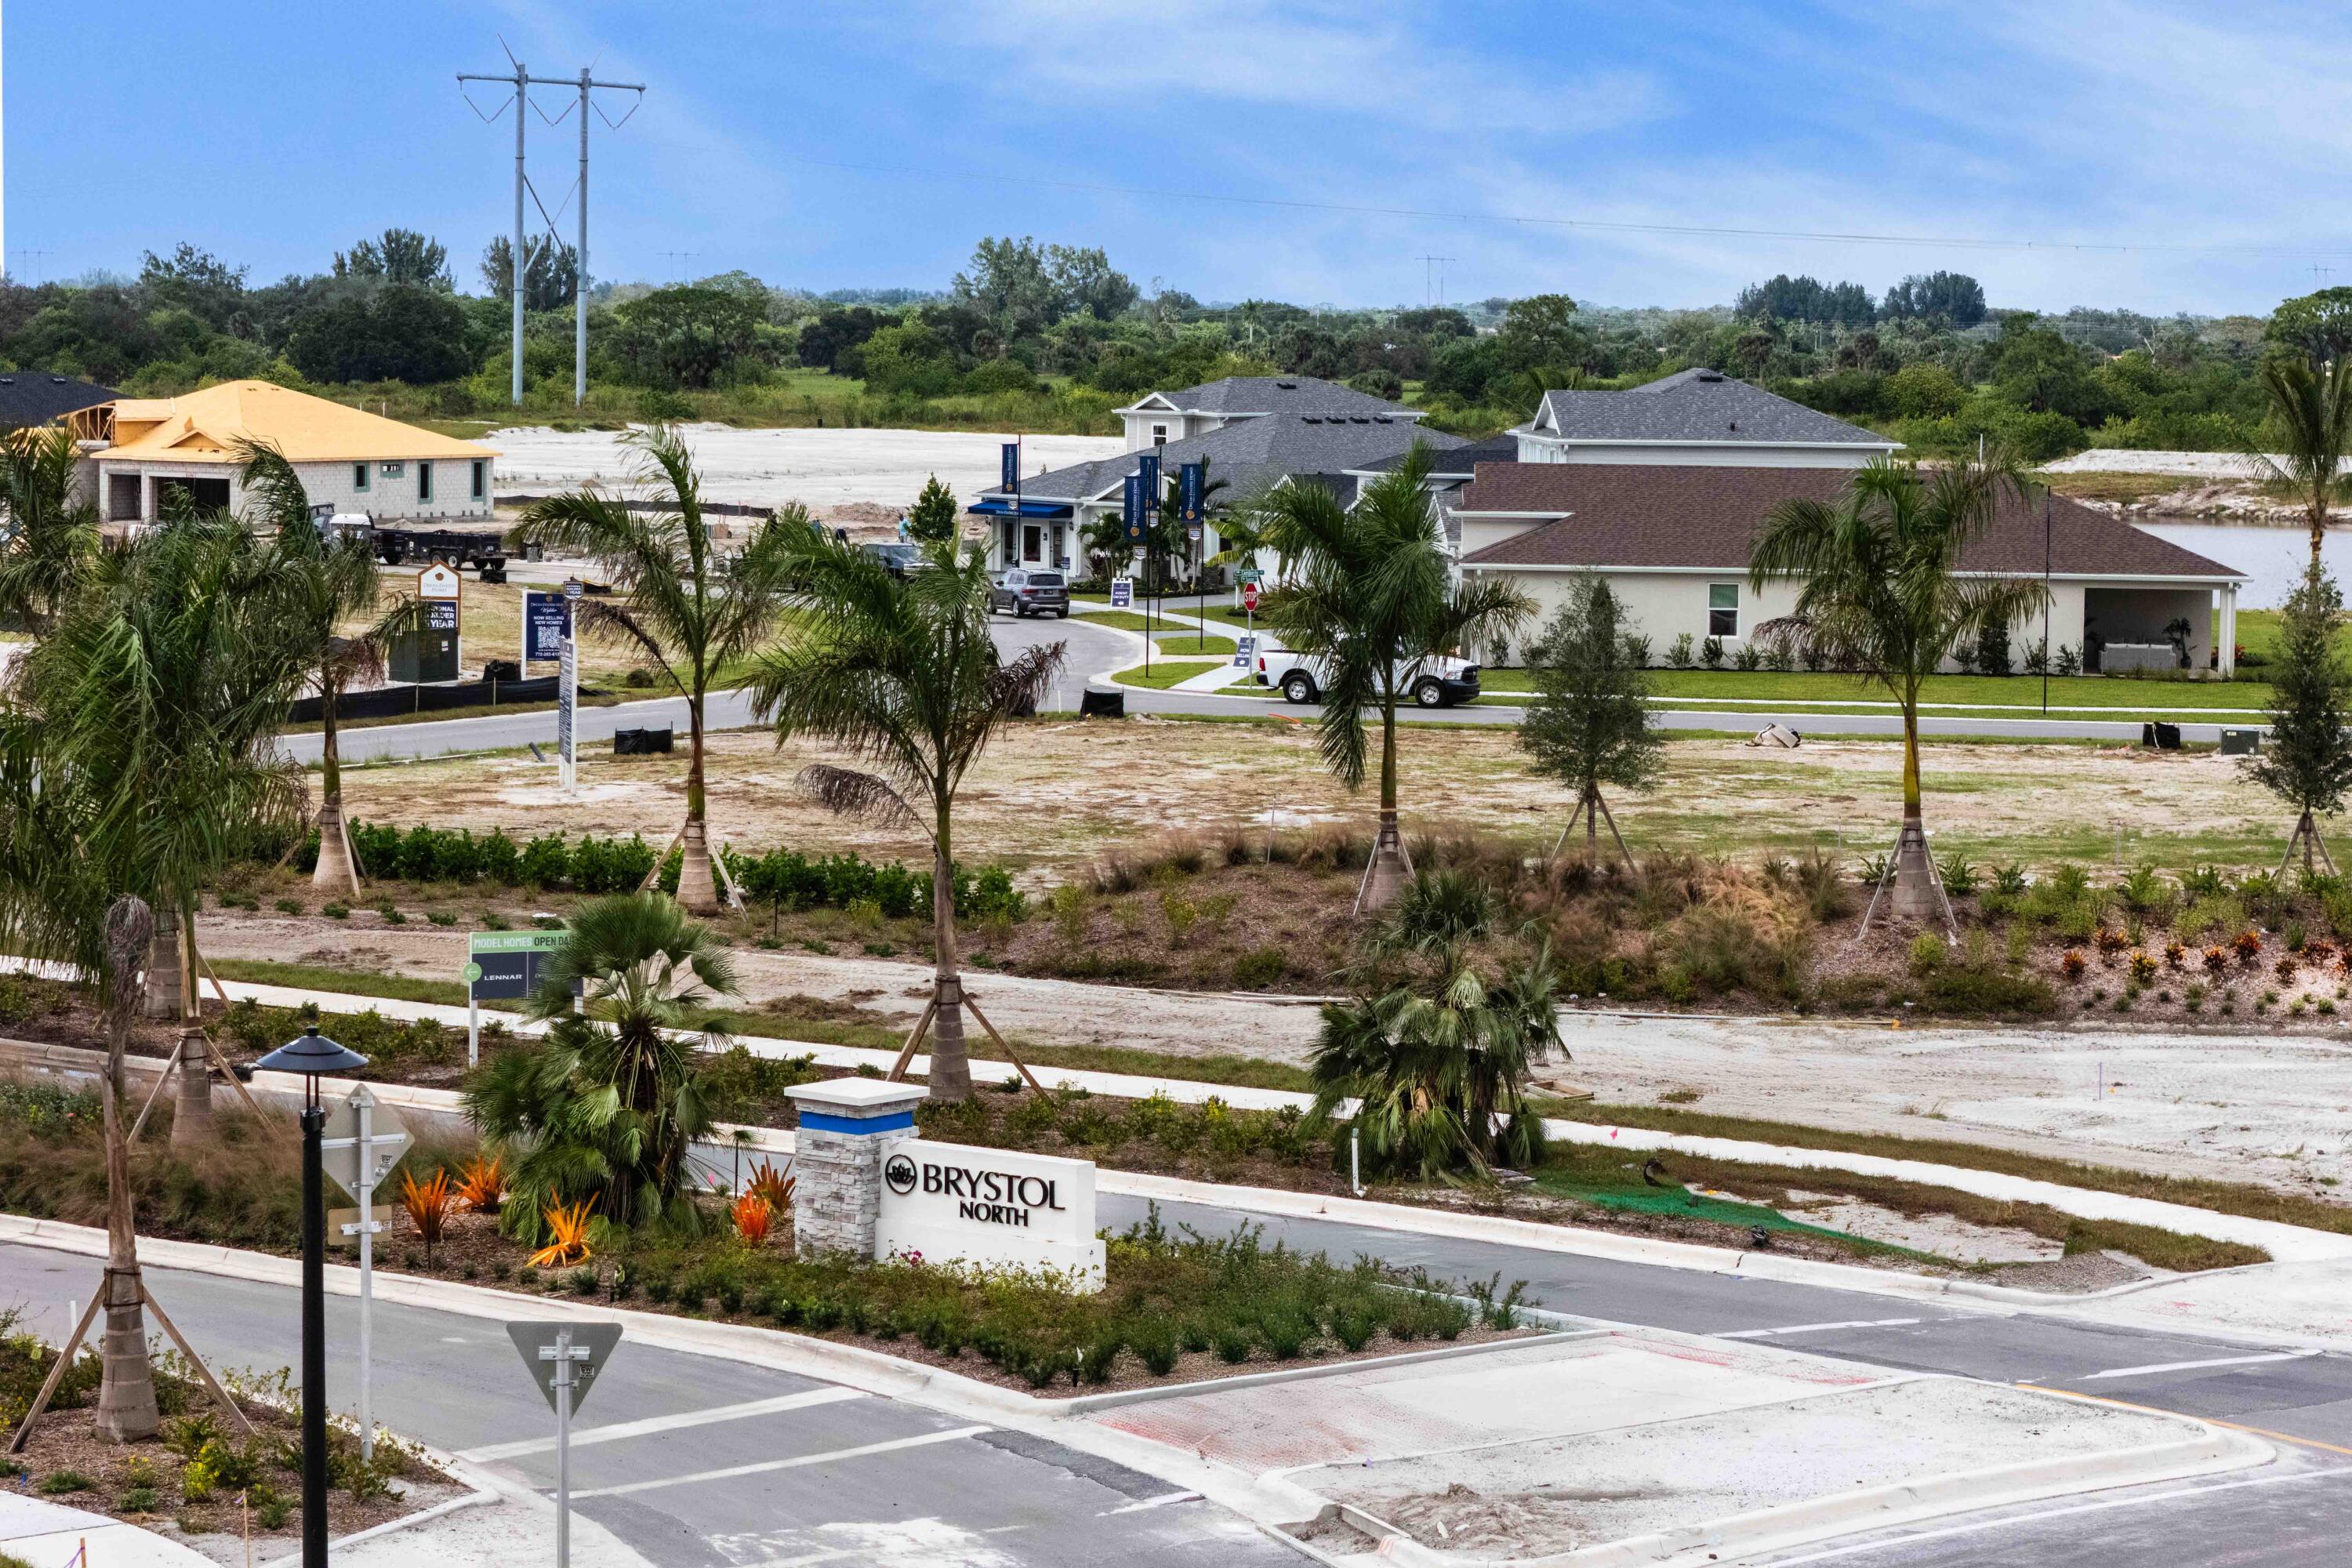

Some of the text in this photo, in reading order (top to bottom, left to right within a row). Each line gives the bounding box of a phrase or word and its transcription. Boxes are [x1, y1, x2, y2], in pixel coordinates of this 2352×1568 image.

[1245, 591, 1257, 602] STOP
[430, 619, 455, 628] YEAR
[474, 938, 503, 949] MODEL
[503, 937, 532, 947] HOMES
[534, 936, 556, 946] OPEN
[923, 1163, 1065, 1210] BRYSTOL
[960, 1200, 1029, 1227] NORTH
